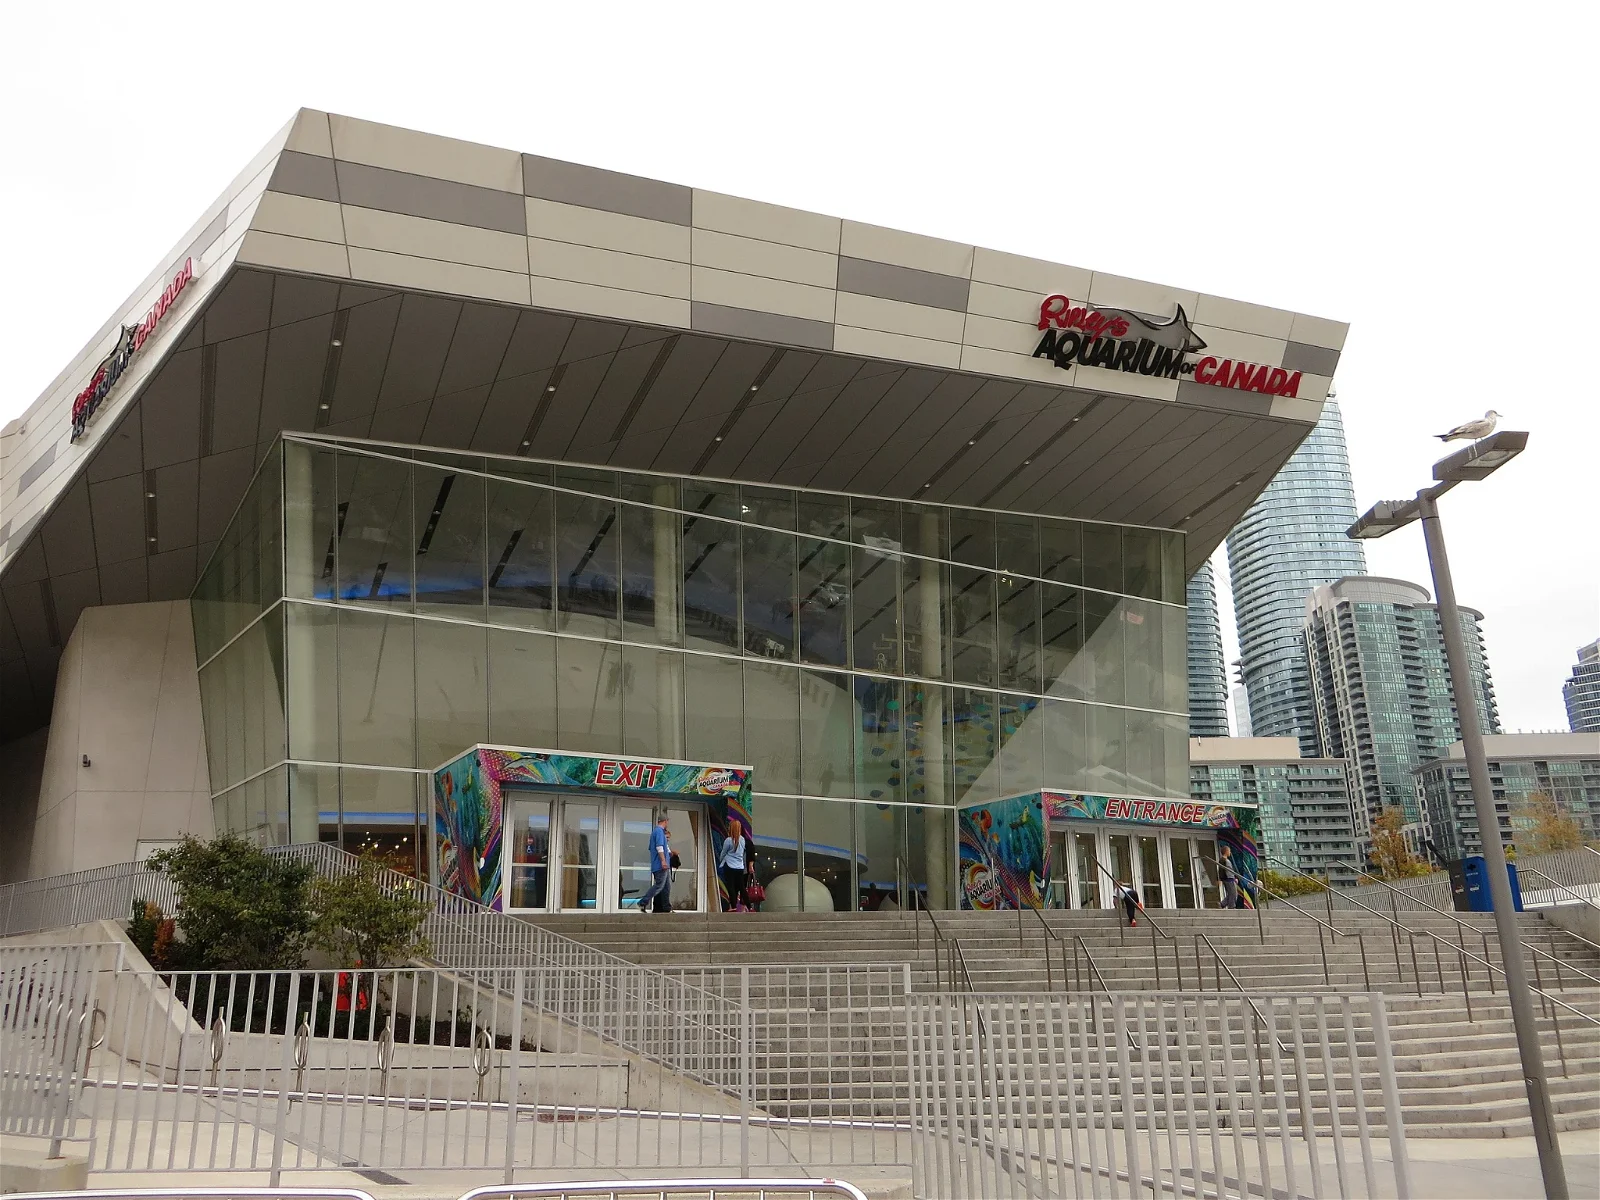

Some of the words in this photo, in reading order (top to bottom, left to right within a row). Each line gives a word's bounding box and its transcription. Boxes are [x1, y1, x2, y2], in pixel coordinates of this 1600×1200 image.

[134, 256, 192, 351] CANADA
[1032, 329, 1185, 379] AQUARIUM
[1180, 361, 1197, 375] OF
[1194, 355, 1303, 398] CANADA
[595, 760, 664, 788] EXIT
[1105, 798, 1206, 823] ENTRANCE
